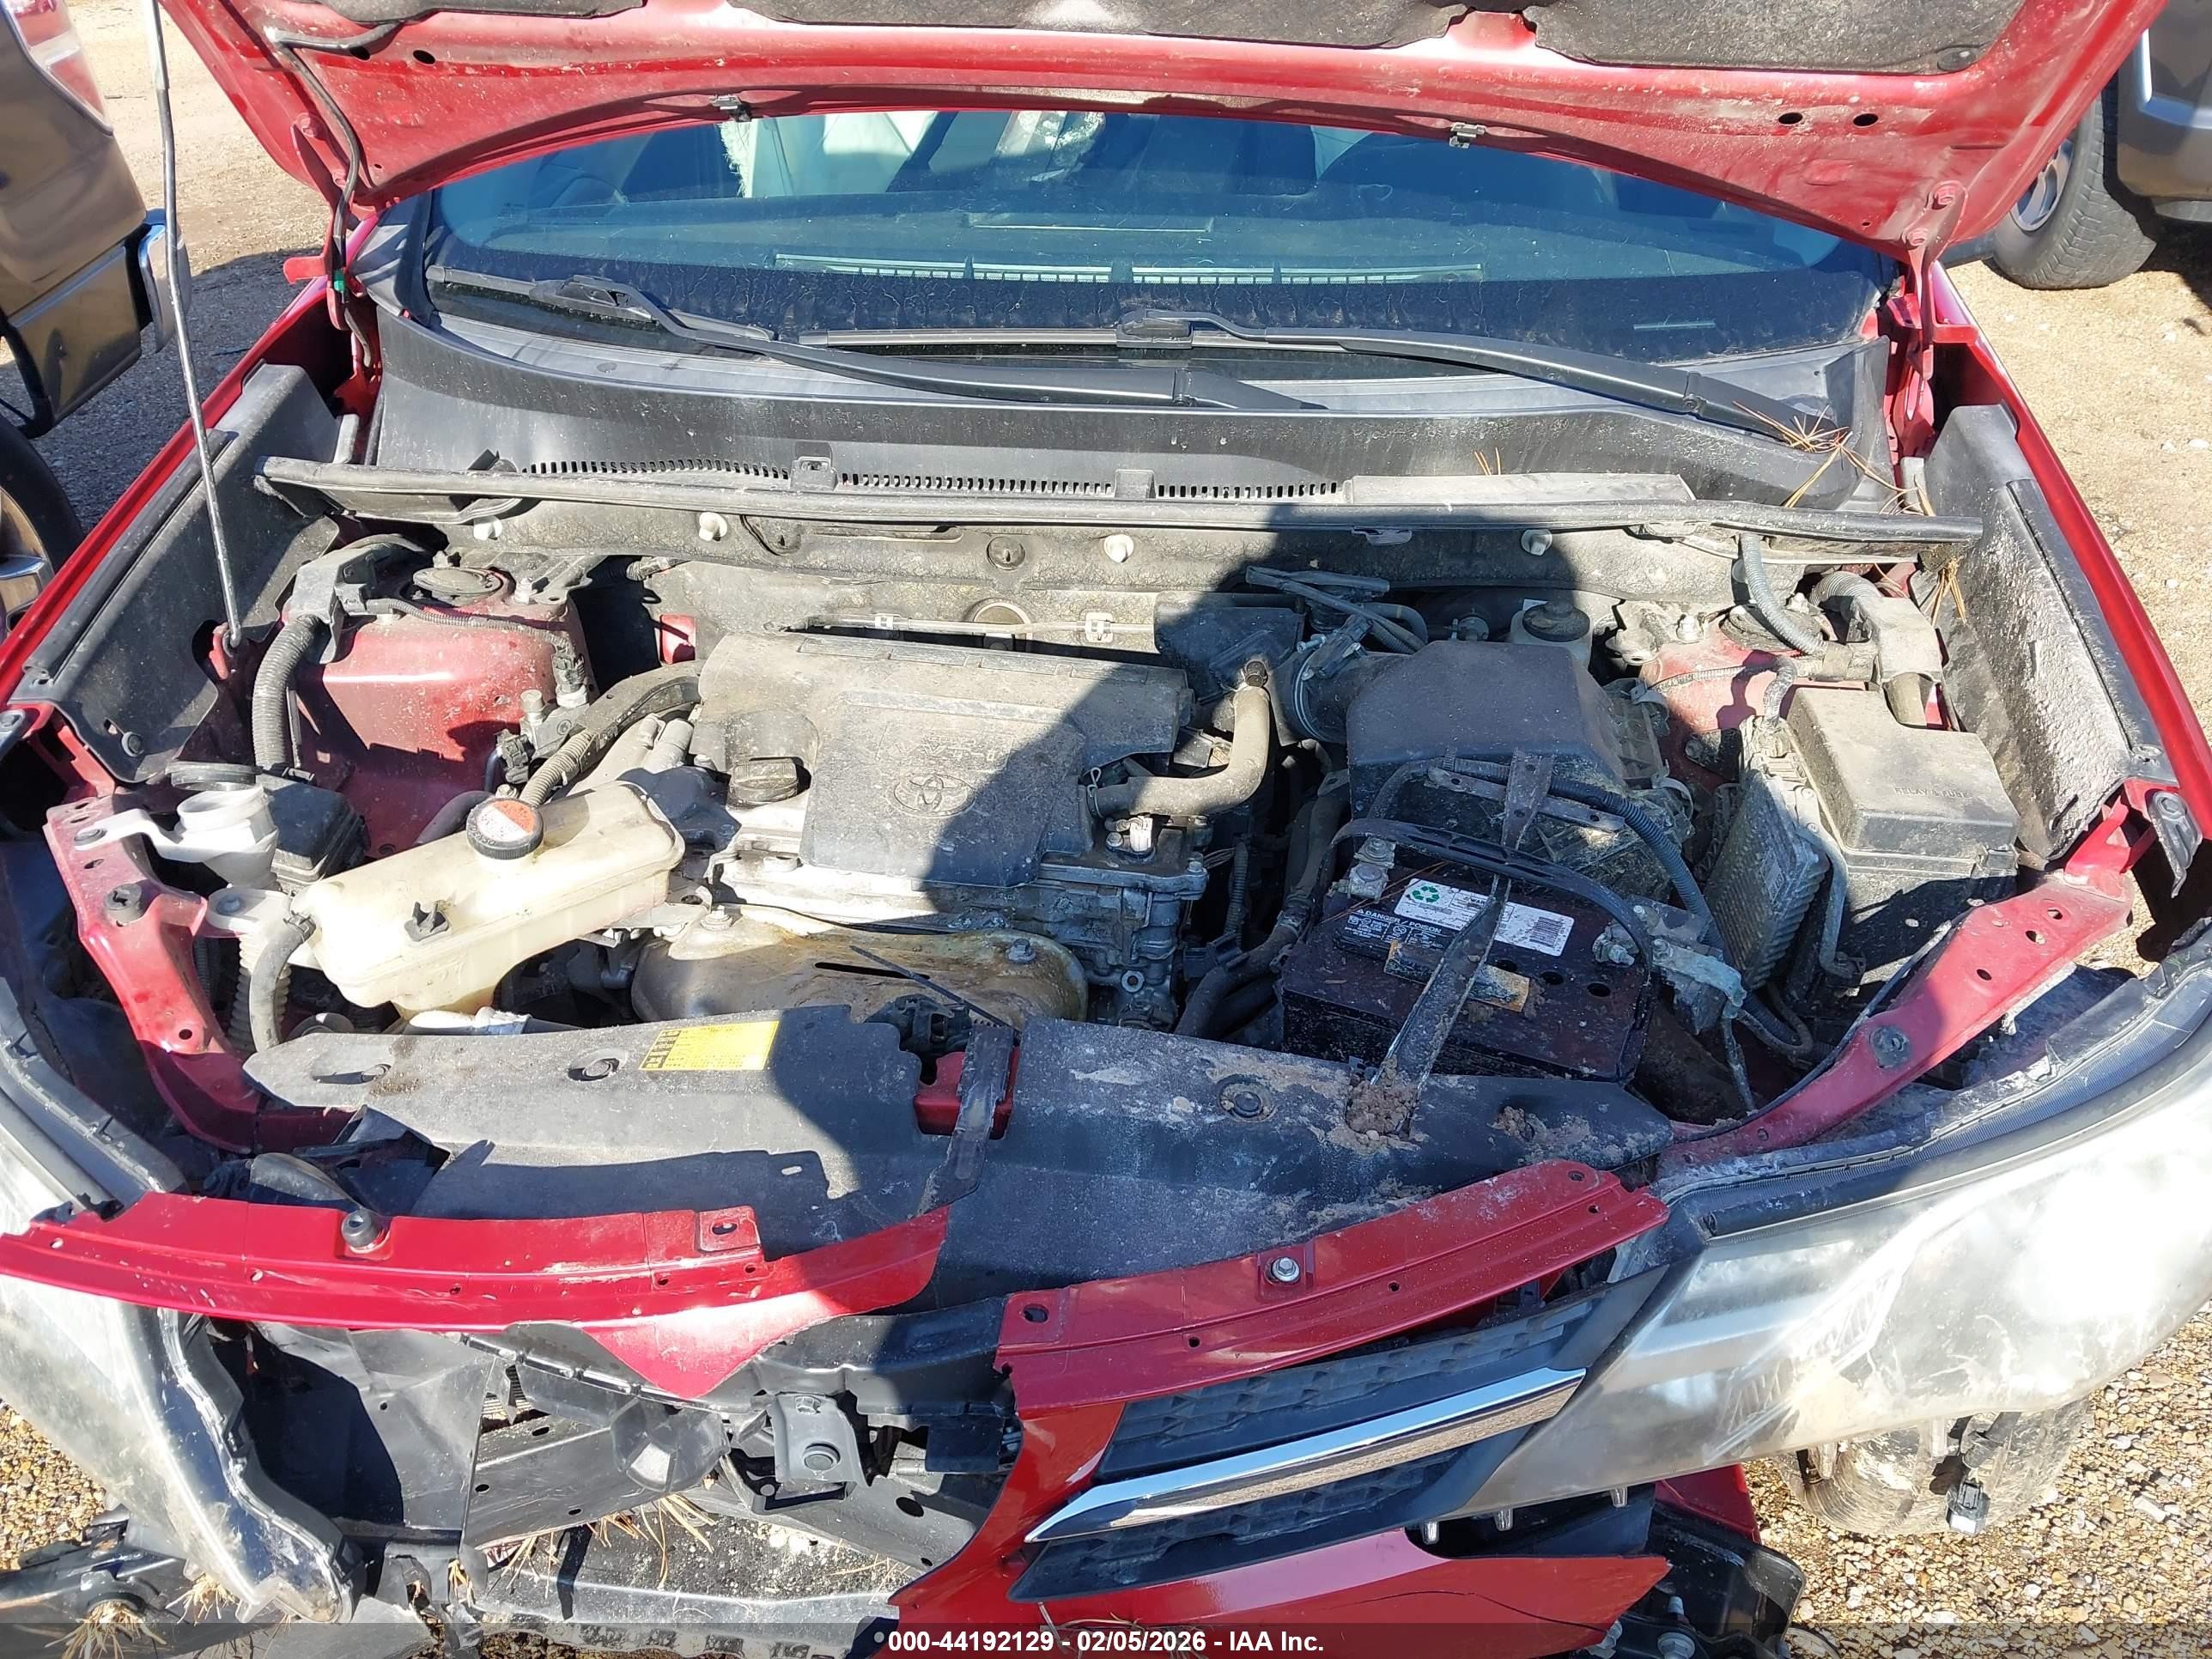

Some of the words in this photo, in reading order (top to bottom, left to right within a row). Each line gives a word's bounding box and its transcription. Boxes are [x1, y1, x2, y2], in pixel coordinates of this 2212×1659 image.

[1893, 787, 1928, 797] RELAY
[1364, 910, 1401, 924] DANGER
[1409, 921, 1443, 934] POISON
